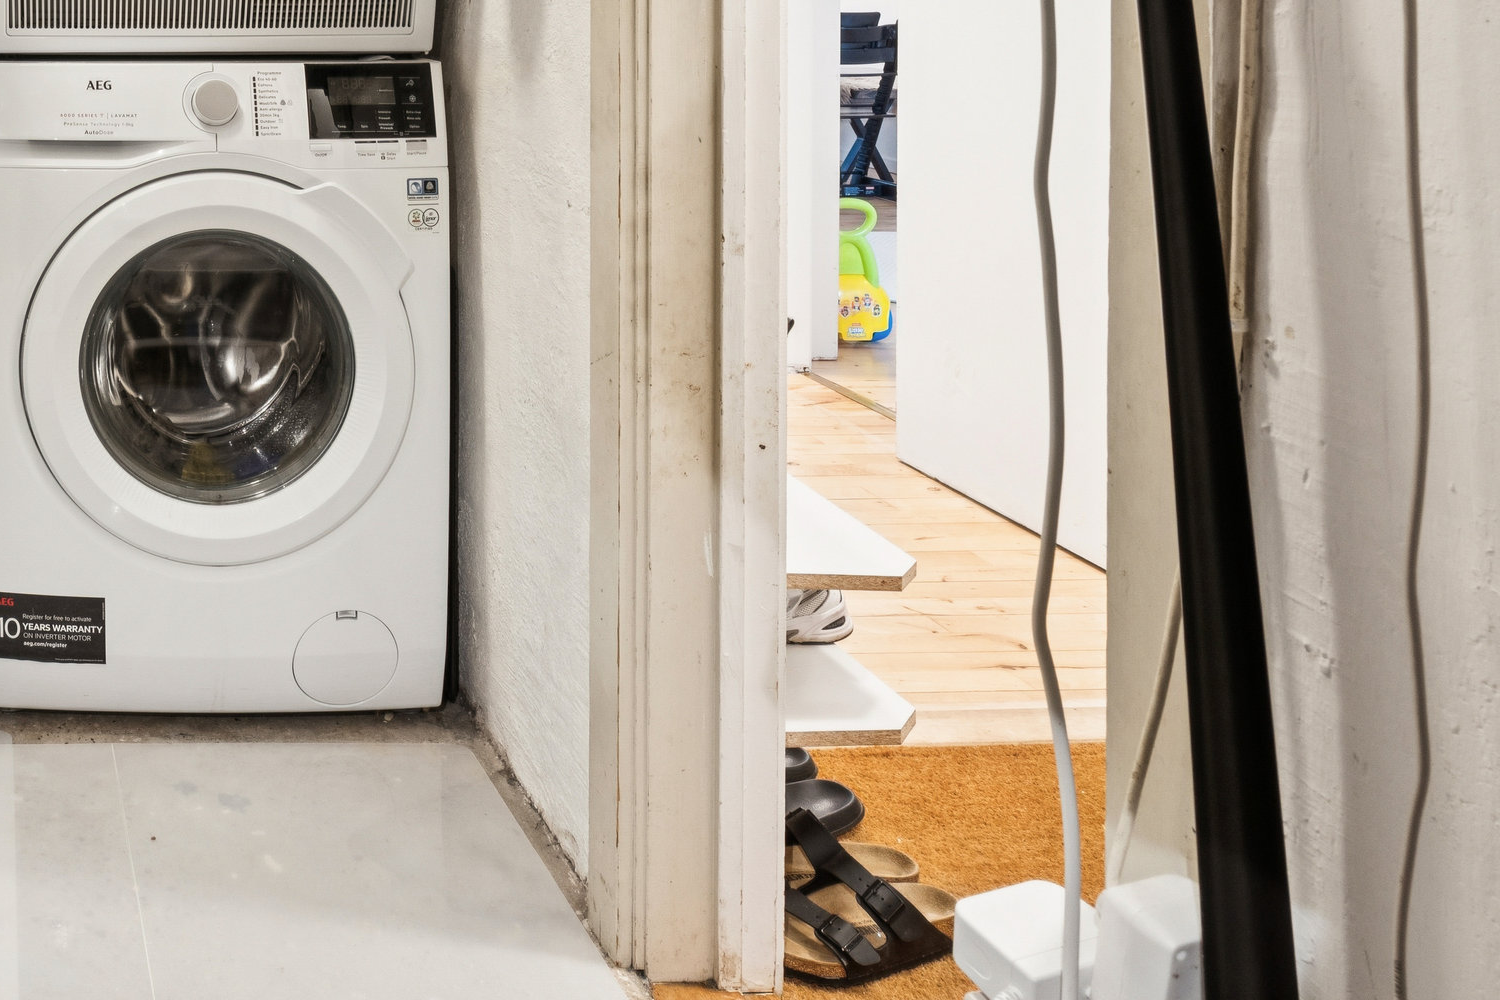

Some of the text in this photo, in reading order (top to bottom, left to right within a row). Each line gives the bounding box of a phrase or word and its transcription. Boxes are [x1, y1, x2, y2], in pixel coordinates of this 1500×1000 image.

[86, 80, 112, 90] AEG
[22, 613, 44, 621] Register
[22, 623, 103, 633] YEARS WARRANTY
